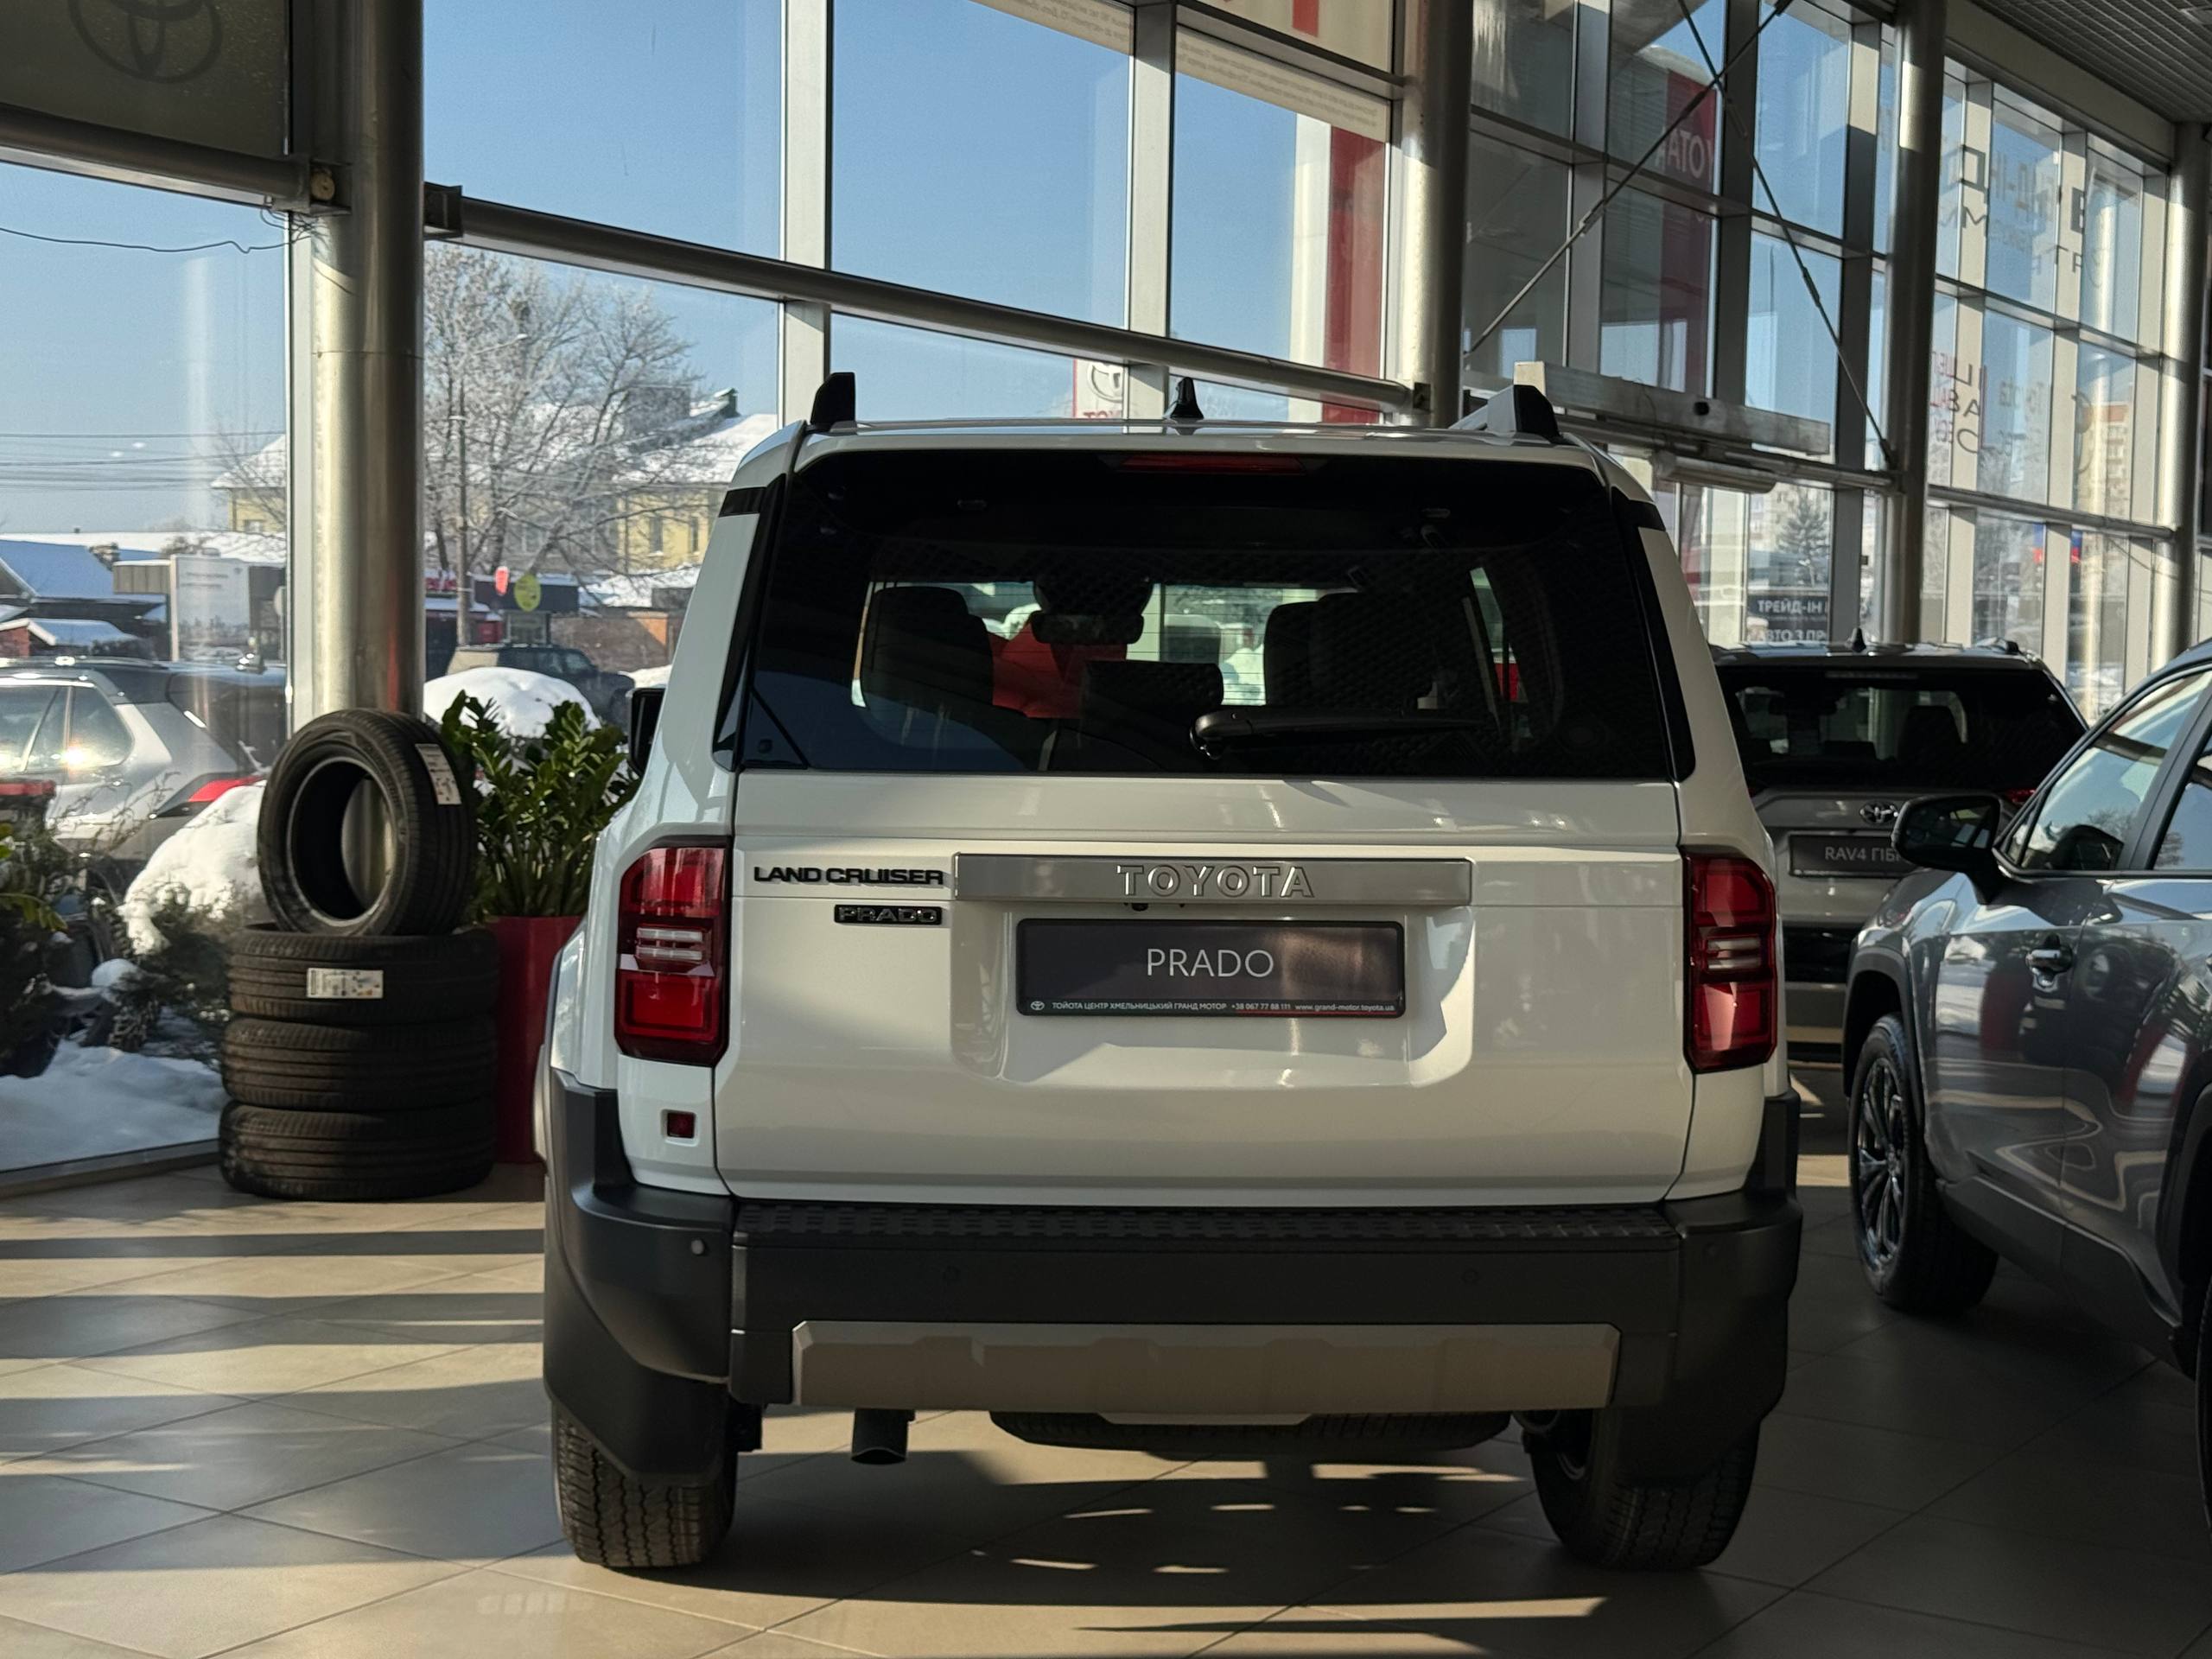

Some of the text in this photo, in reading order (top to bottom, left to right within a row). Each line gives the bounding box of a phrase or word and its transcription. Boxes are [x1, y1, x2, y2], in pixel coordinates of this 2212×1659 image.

[1757, 598, 1823, 614] ТРЕЙД-ІН
[1824, 846, 1866, 861] RAV4
[753, 867, 944, 885] LAND CRUISER
[1116, 864, 1315, 898] TOYOTA
[837, 906, 938, 924] PRADO
[1146, 948, 1274, 978] PRADO
[1052, 1001, 1084, 1010] ТОЙОТА
[1084, 1002, 1109, 1011] ЦЕНТР
[1109, 1001, 1173, 1011] ХМЕЛЬНИЦЬКИЙ
